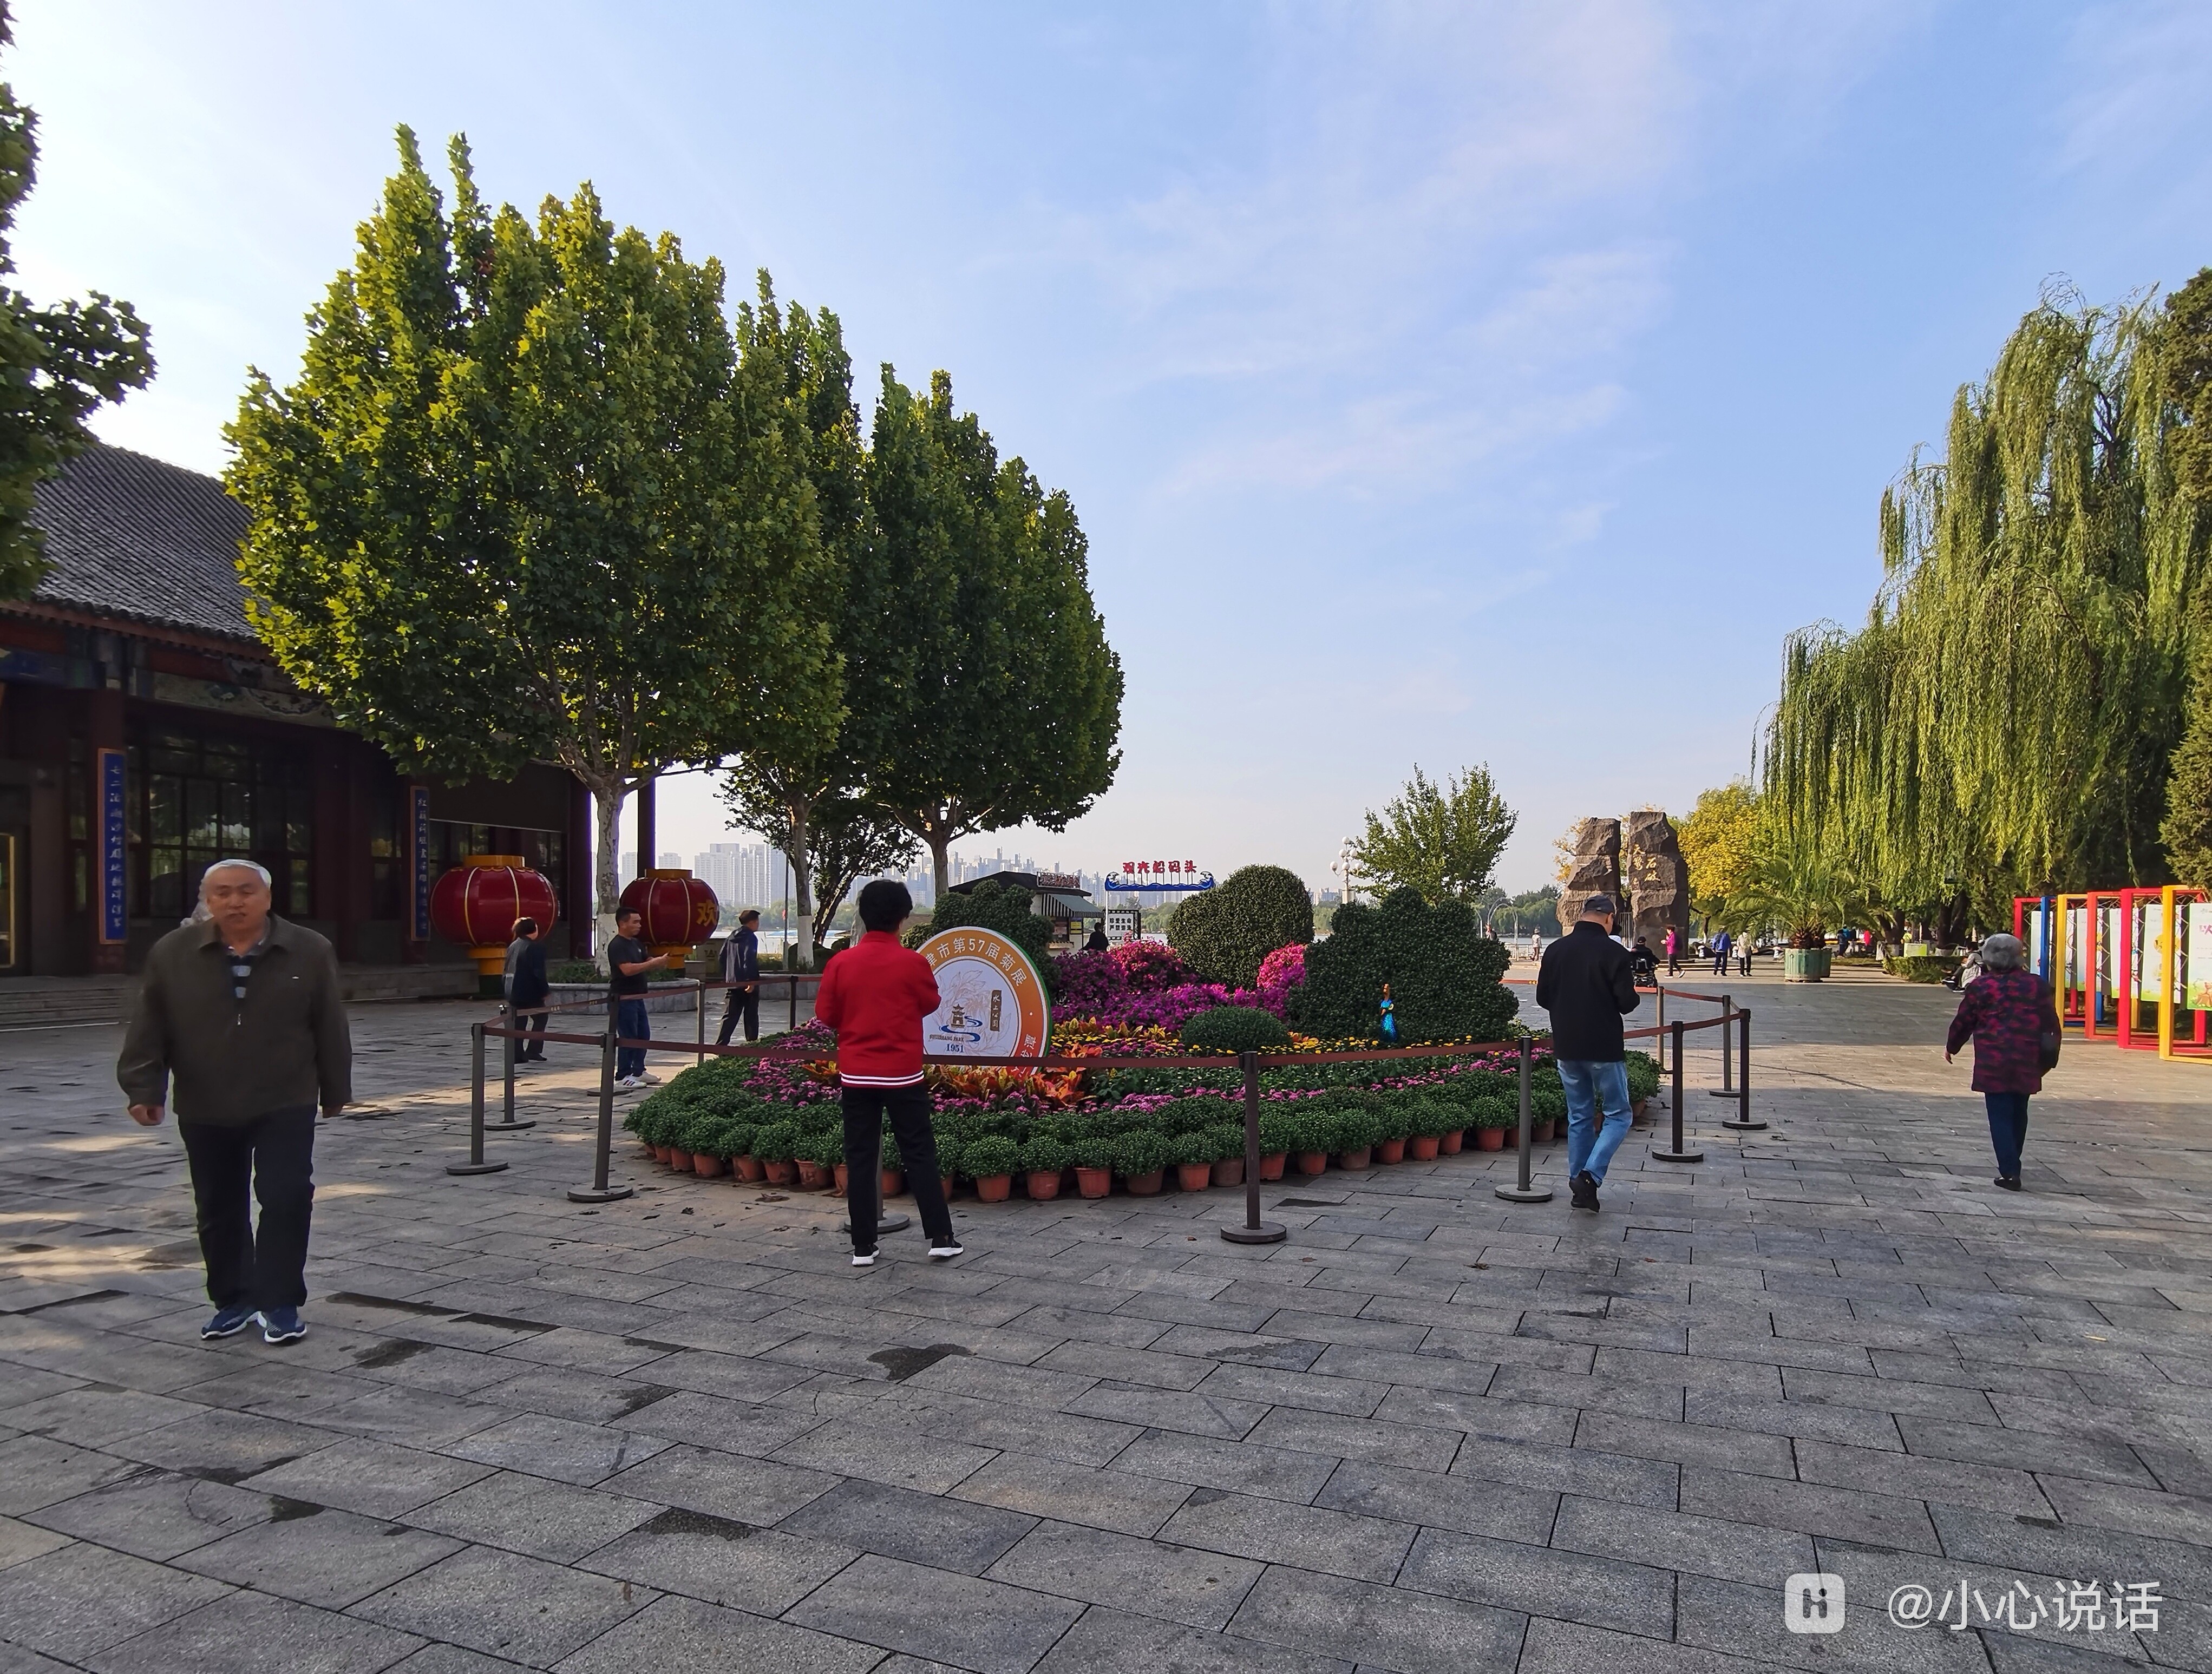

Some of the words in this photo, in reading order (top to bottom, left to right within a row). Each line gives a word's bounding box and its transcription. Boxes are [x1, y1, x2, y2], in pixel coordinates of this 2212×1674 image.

[1122, 860, 1197, 874] 观光船码头
[946, 1043, 964, 1053] 1951
